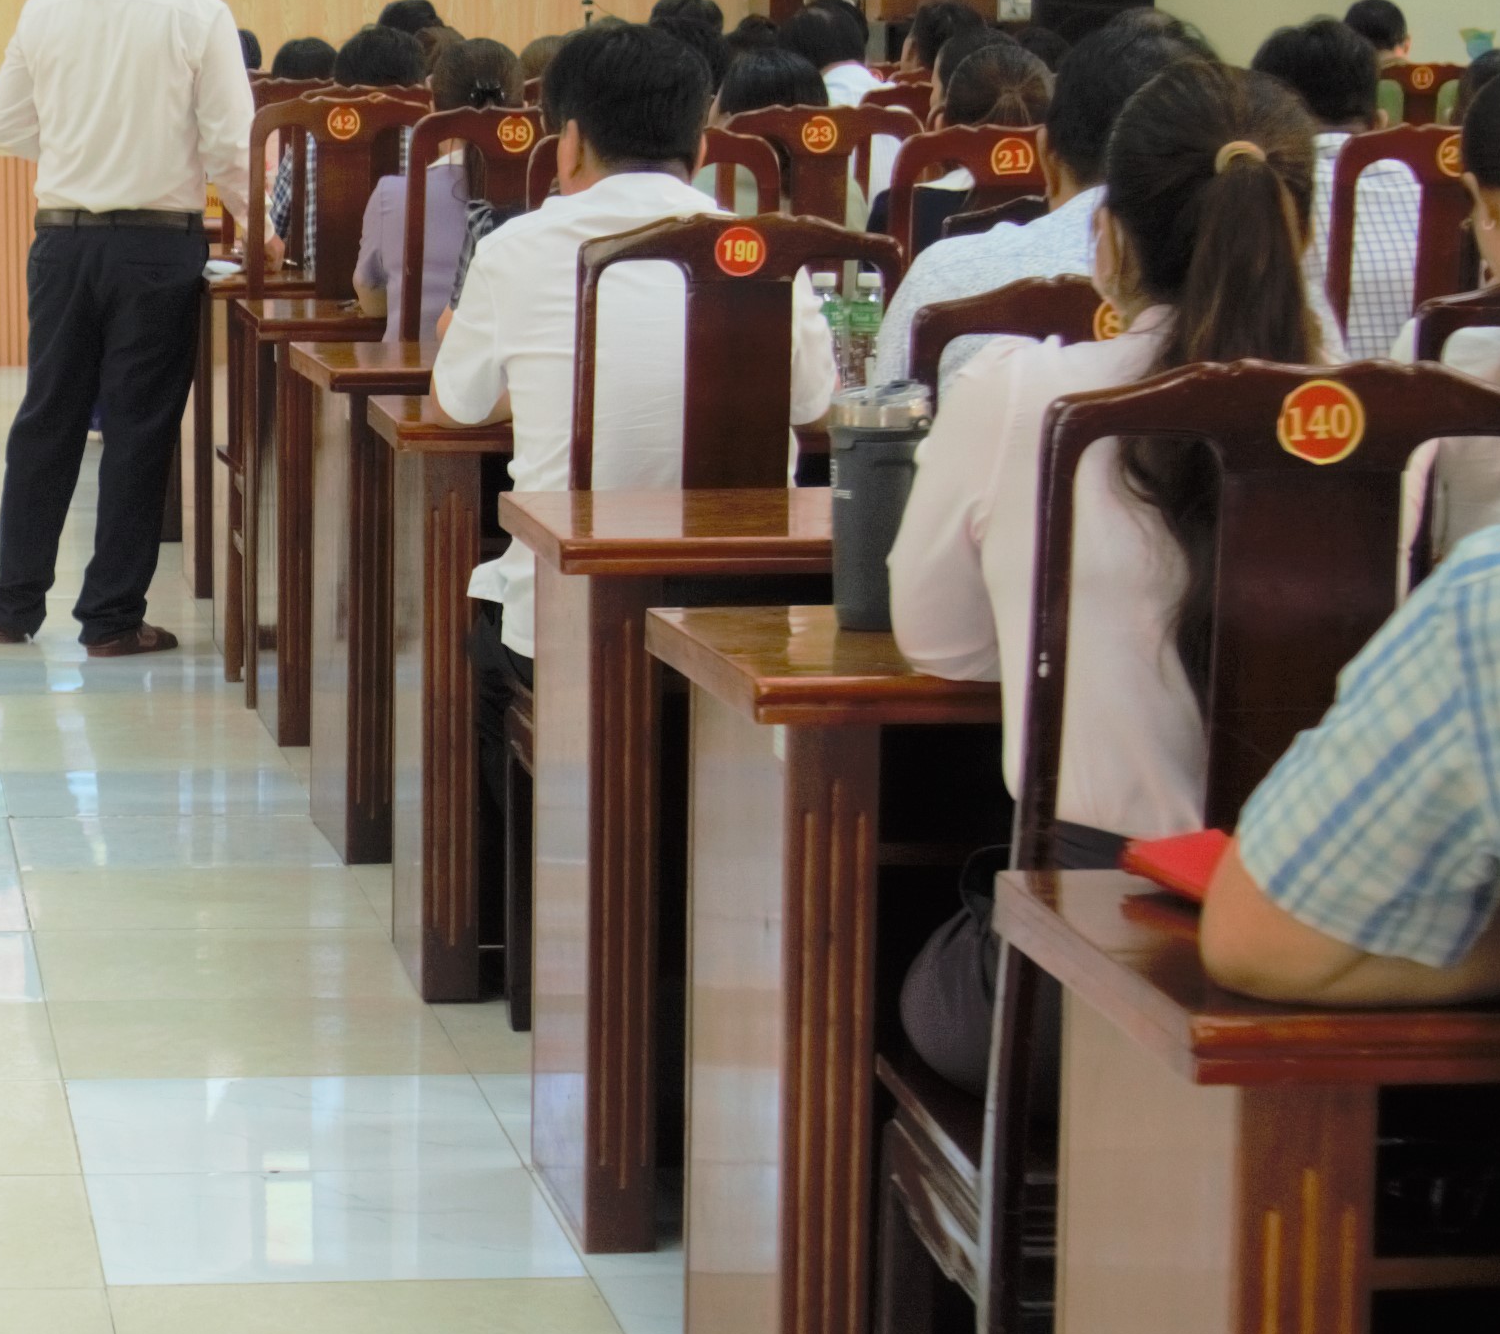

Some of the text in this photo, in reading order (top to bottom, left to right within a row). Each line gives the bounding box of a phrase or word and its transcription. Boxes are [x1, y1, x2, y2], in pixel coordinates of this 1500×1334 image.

[331, 114, 357, 131] 42
[499, 125, 528, 142] 58
[805, 125, 832, 143] 23
[998, 147, 1028, 167] 21
[723, 238, 760, 260] 190
[1288, 408, 1352, 441] 140
